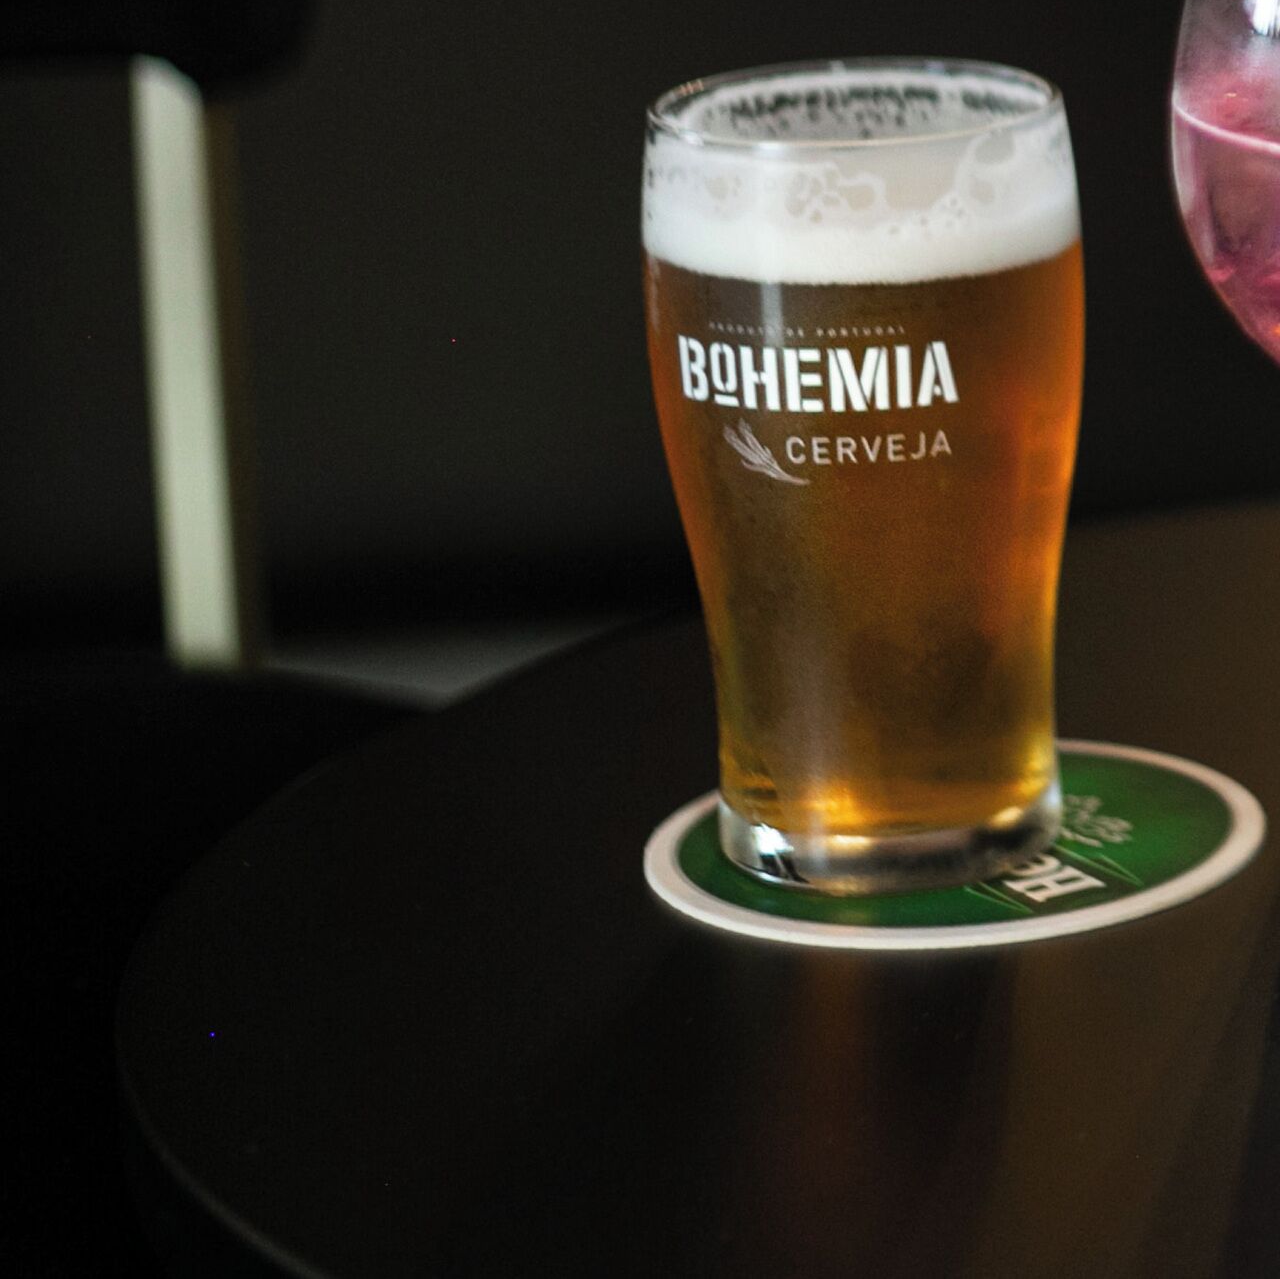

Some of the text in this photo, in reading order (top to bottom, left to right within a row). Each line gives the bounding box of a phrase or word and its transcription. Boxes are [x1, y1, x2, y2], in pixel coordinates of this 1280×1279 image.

[815, 324, 906, 339] PORTUGAL
[678, 333, 959, 413] BOHEMIA
[786, 429, 952, 465] CERVEJA
